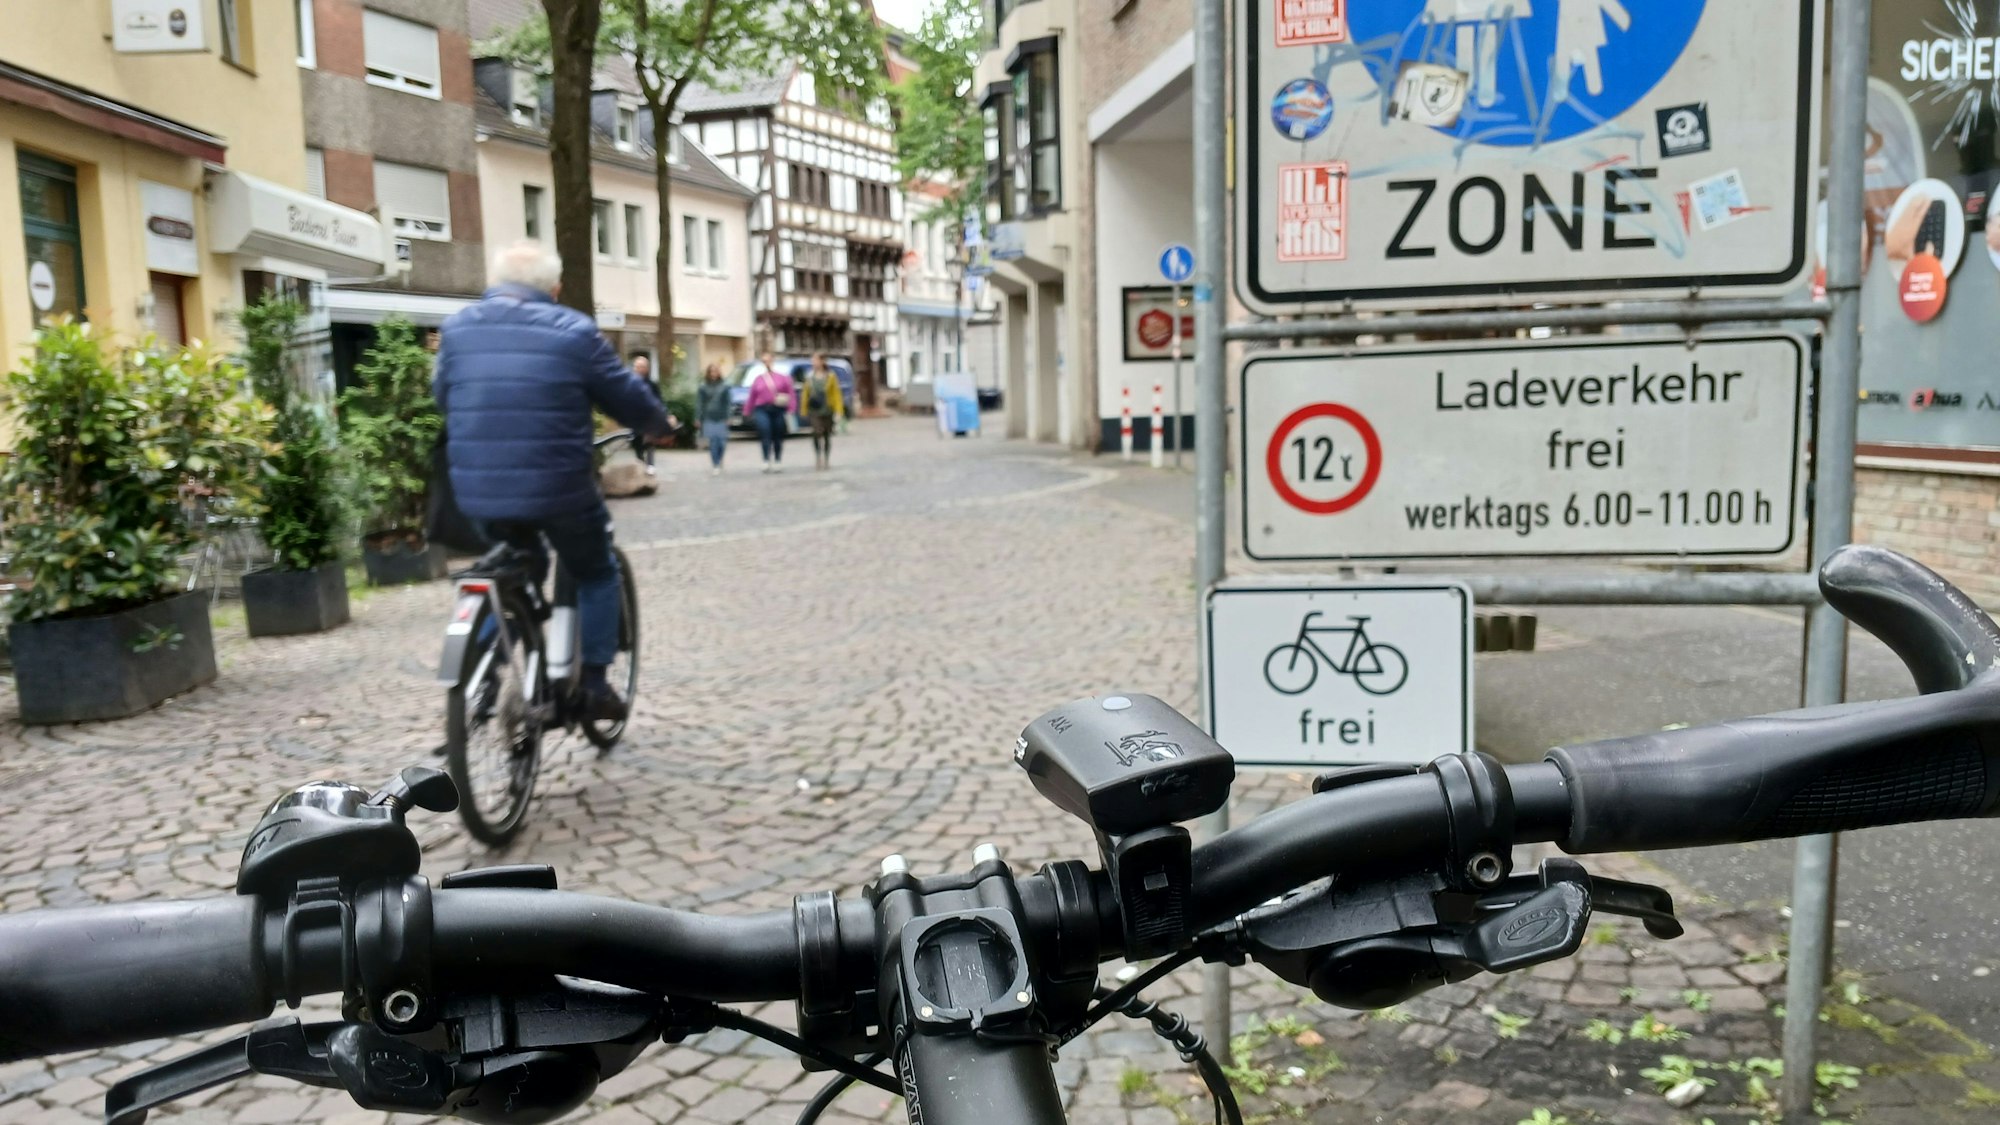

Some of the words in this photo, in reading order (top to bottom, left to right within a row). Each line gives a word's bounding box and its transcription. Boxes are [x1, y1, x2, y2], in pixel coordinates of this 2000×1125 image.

[1900, 37, 2000, 82] SICHE
[1385, 167, 1658, 259] ZONE
[1436, 361, 1744, 412] Ladeverkehr
[1547, 427, 1626, 470] frei
[1404, 495, 1551, 537] werktags
[1754, 490, 1773, 526] h
[1299, 708, 1375, 745] frei
